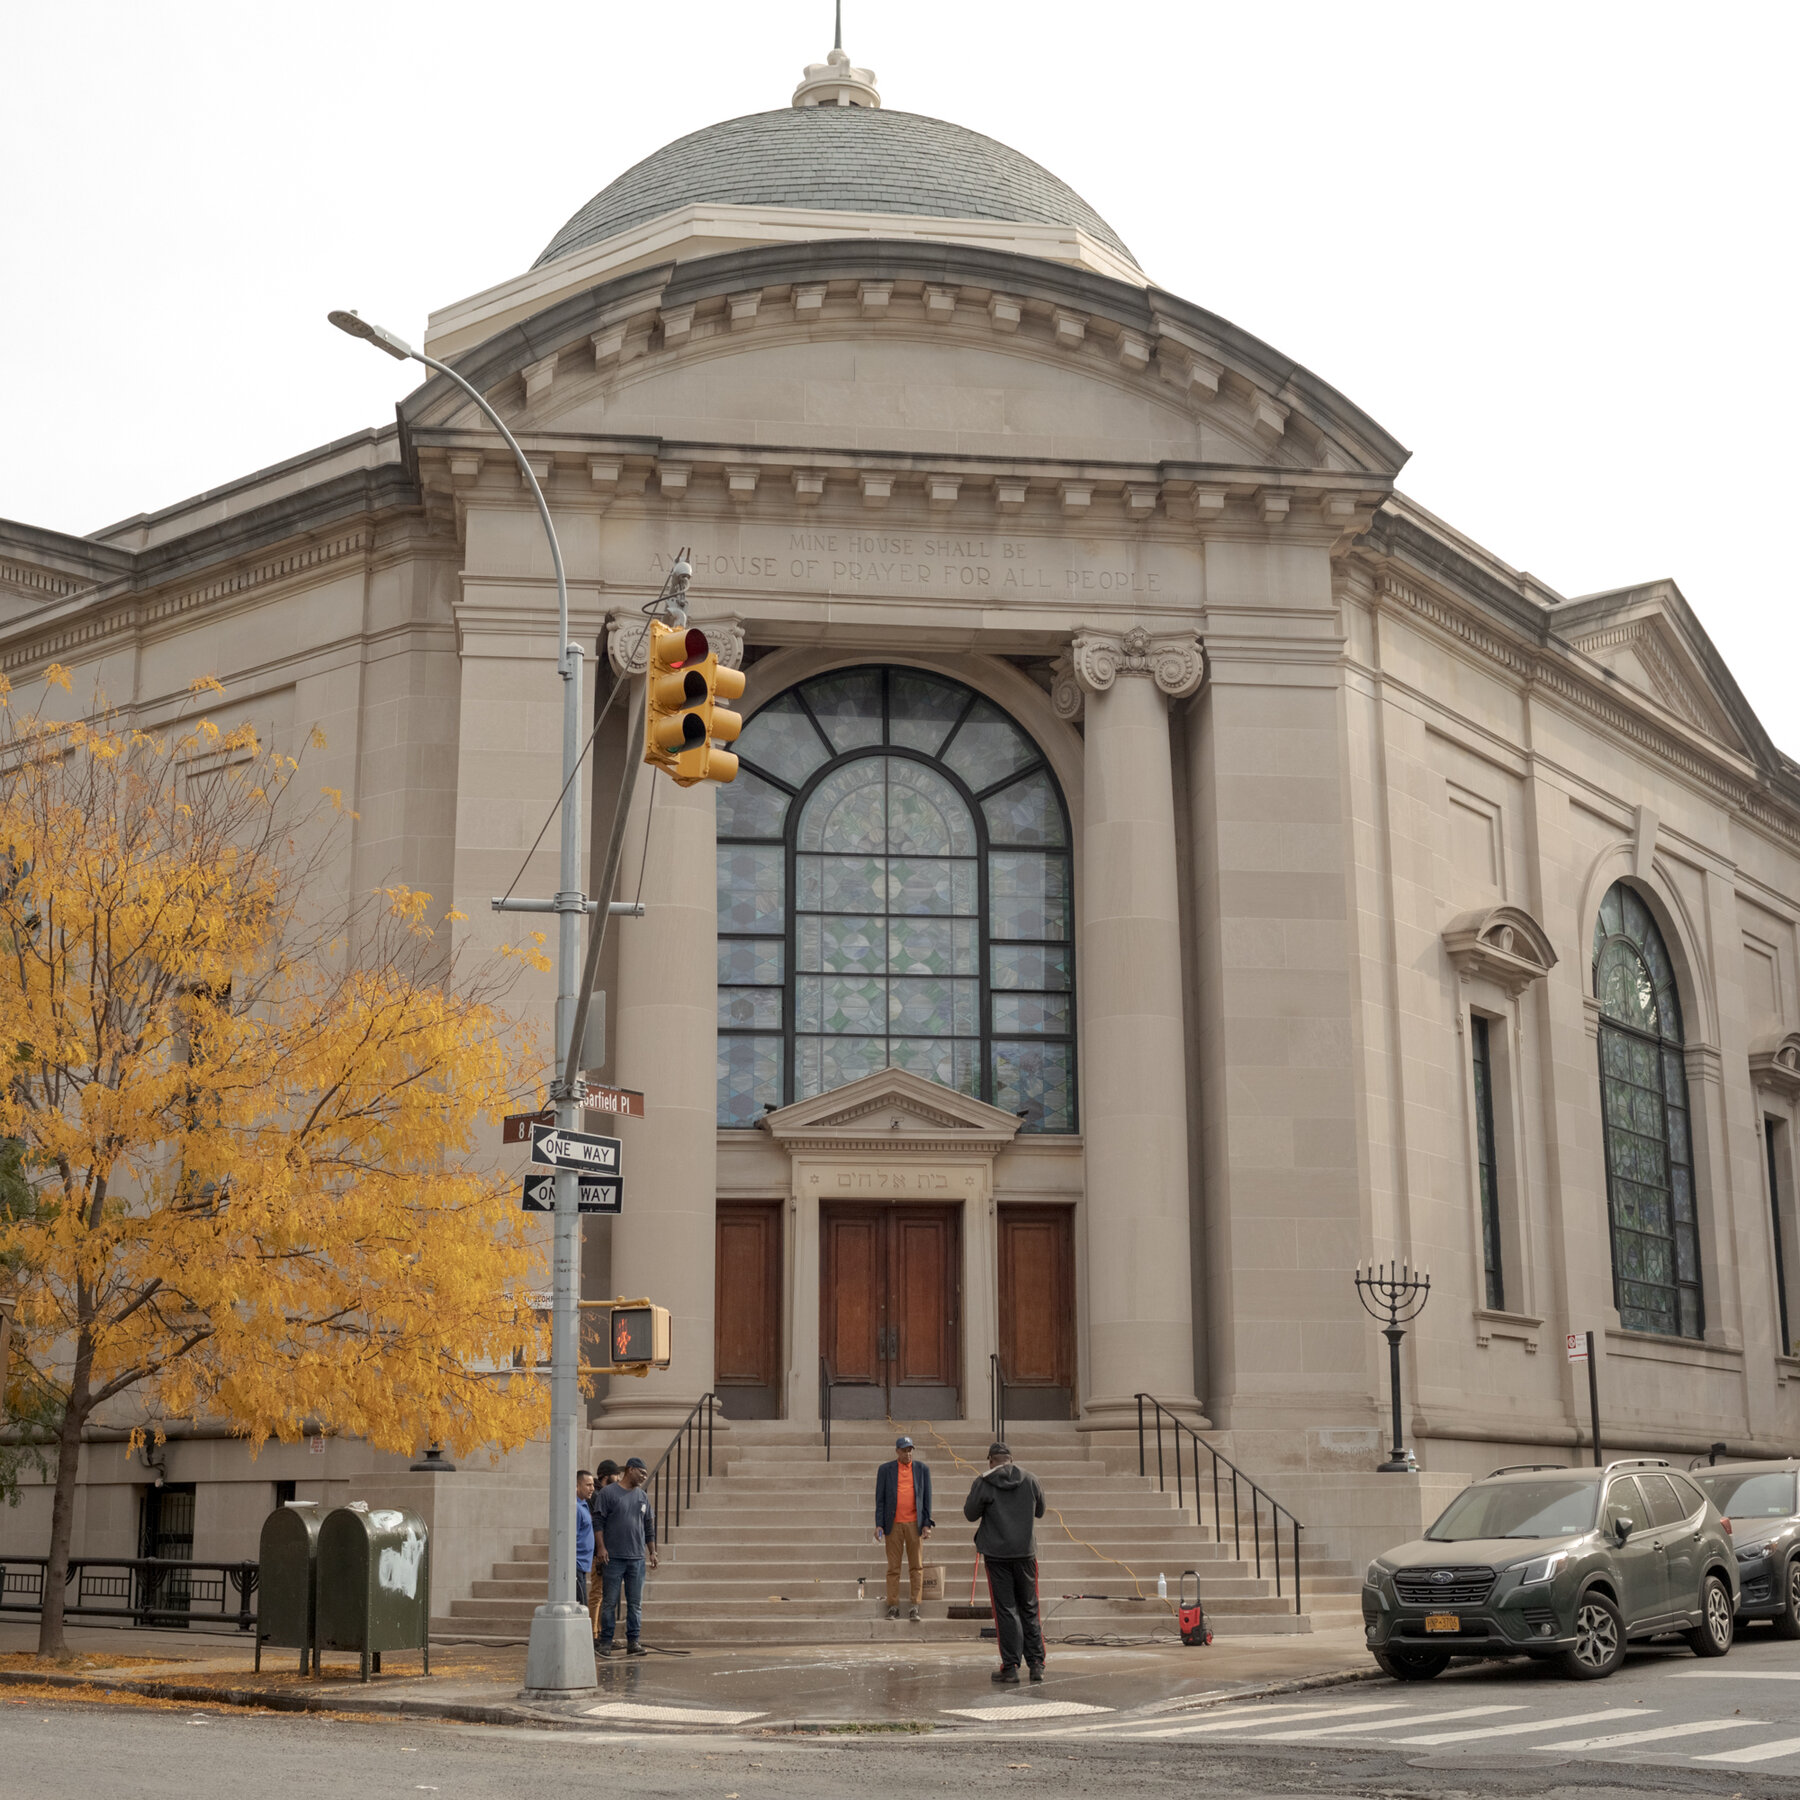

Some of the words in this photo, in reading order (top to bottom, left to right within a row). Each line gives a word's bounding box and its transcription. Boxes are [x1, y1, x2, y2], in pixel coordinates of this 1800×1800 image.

[790, 534, 838, 551] MINE
[849, 536, 913, 555] HOUSE
[924, 540, 990, 558] SHALL
[1002, 543, 1027, 559] BE
[695, 554, 778, 577] HOUSE
[790, 559, 819, 578] OF
[833, 561, 931, 583] PRAYER
[944, 565, 991, 586] FOR
[1003, 568, 1051, 588] ALL
[1065, 569, 1161, 592] PEOPLE
[621, 1095, 630, 1114] Pl
[518, 1121, 525, 1139] 8
[546, 1139, 571, 1157] ONE
[583, 1145, 610, 1162] WAY
[918, 1173, 948, 1189] בית
[539, 1186, 555, 1201] ON
[581, 1187, 610, 1202] WAY
